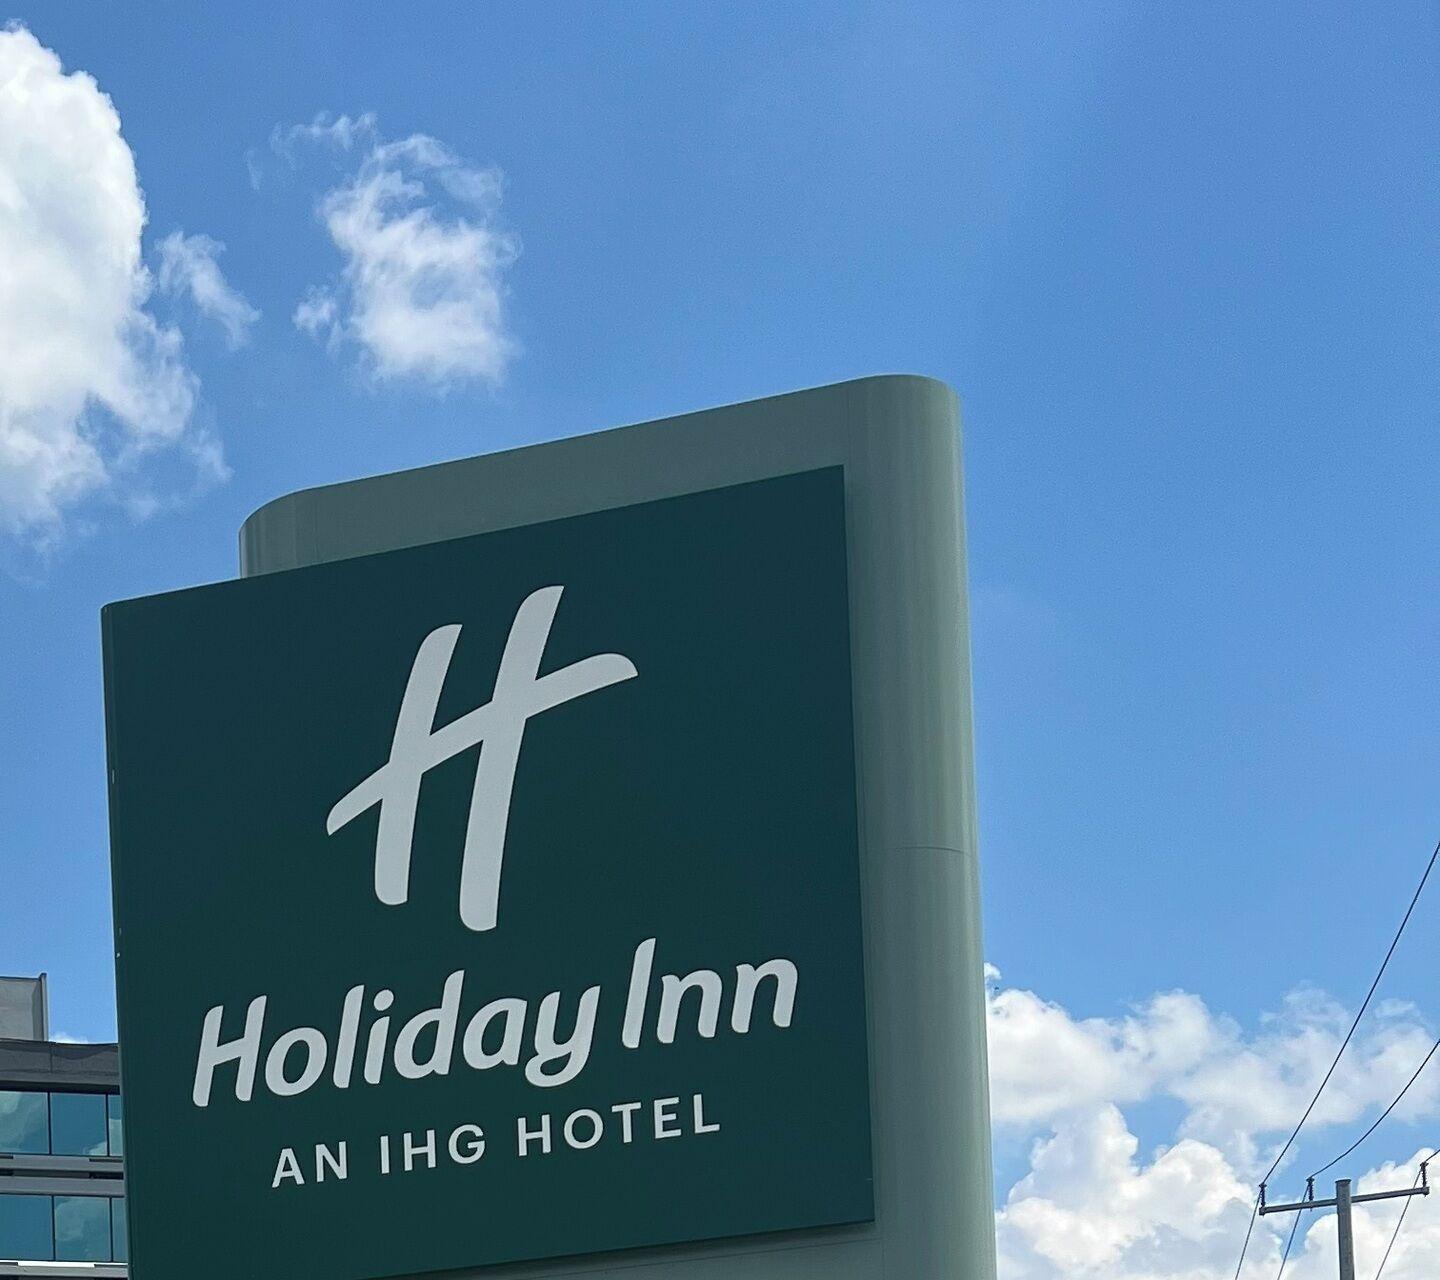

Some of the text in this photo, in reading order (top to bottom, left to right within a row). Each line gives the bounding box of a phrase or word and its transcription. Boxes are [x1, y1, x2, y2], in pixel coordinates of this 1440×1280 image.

[326, 585, 639, 932] H
[192, 937, 798, 1107] Holiday Inn
[271, 1093, 720, 1188] AN IHG HOTEL
